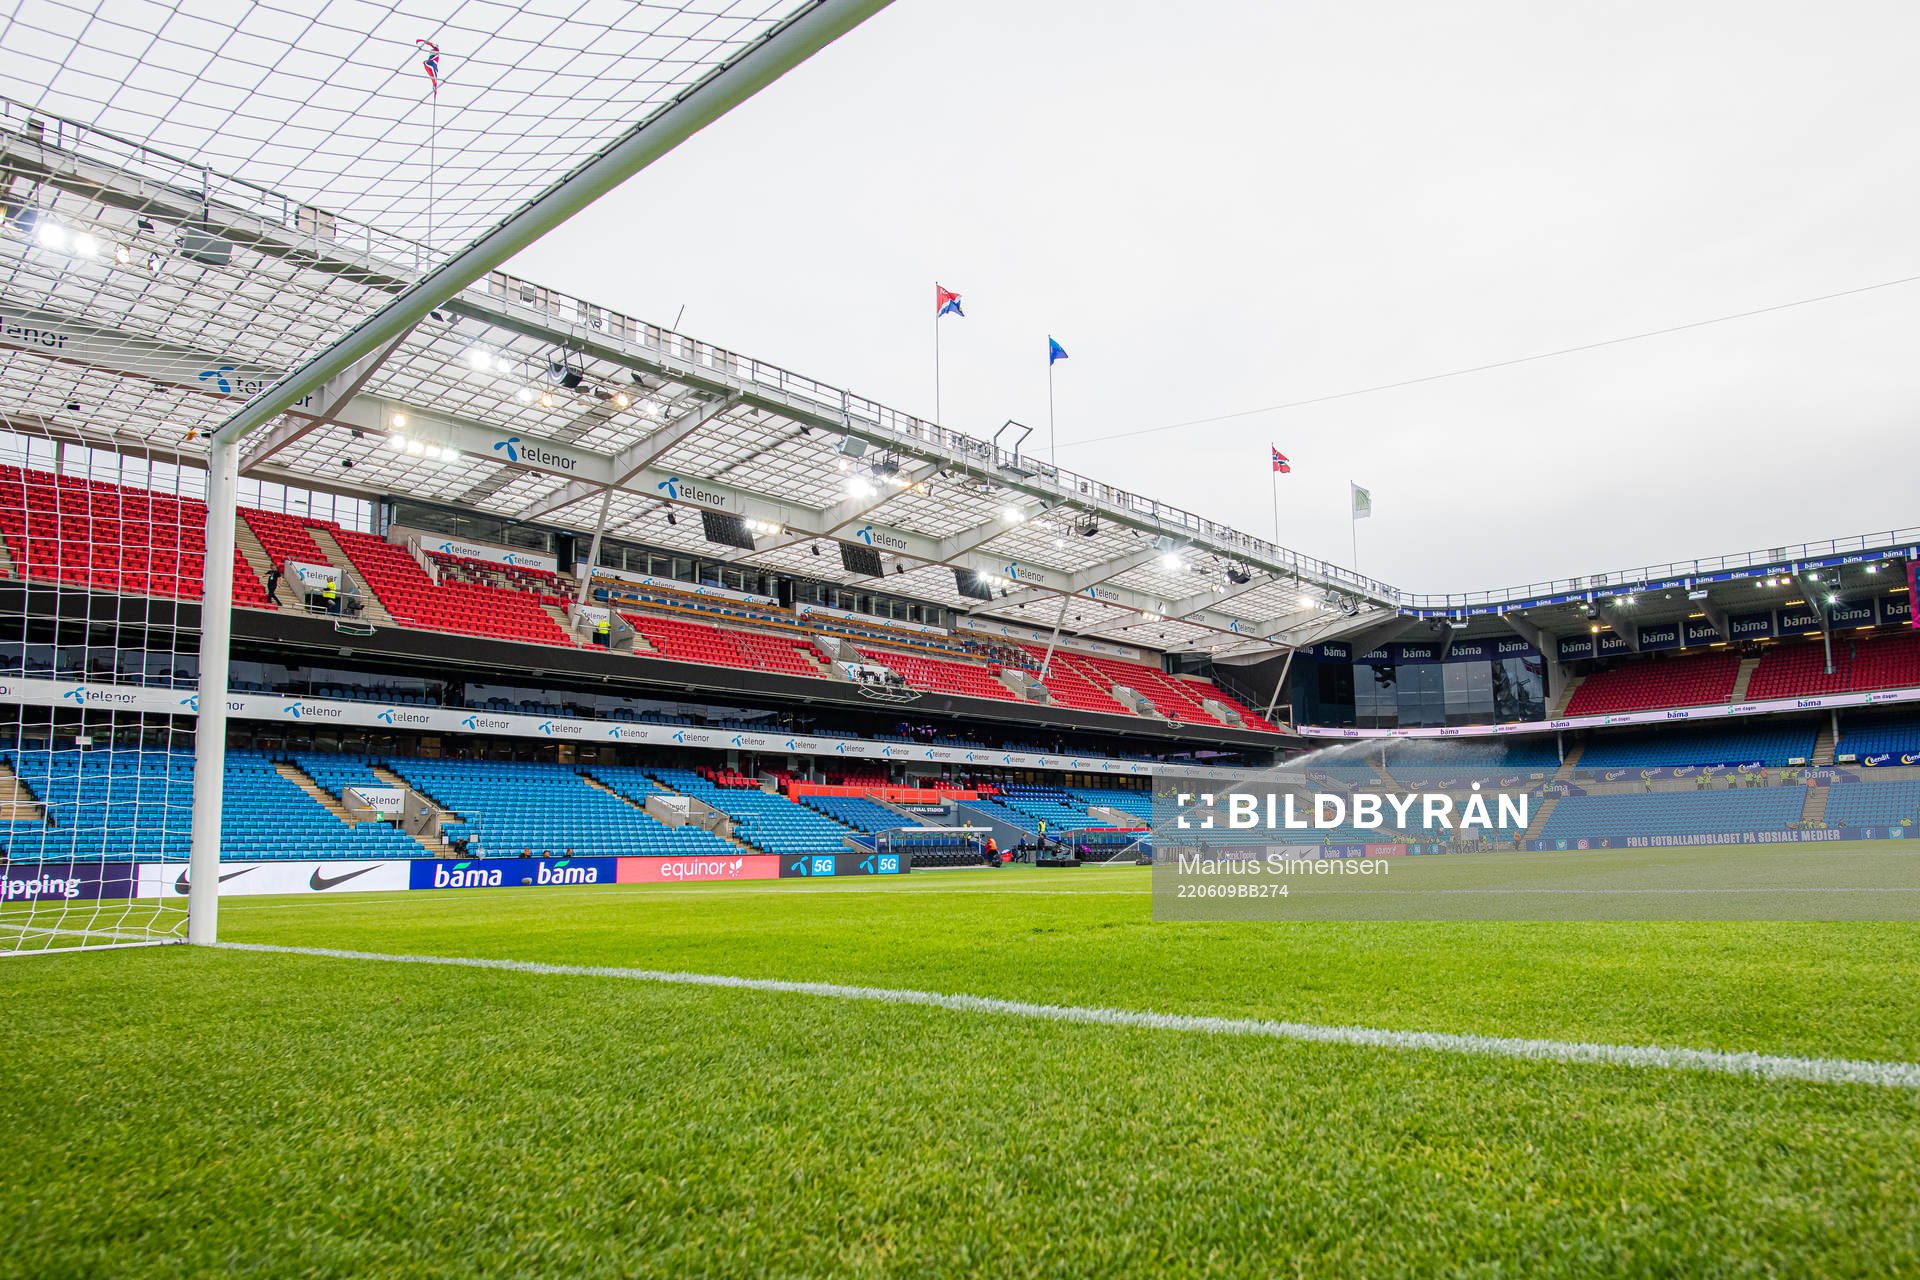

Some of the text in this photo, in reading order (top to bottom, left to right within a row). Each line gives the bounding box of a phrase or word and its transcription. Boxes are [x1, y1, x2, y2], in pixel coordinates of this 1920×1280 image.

[520, 444, 577, 471] telenor
[679, 484, 726, 507] telenor
[872, 532, 907, 550] telenor
[450, 544, 481, 557] telenor
[514, 553, 542, 568] telenor
[306, 570, 338, 582] telenr
[1017, 567, 1045, 583] telenor
[1096, 587, 1120, 601] telenor
[1833, 606, 1871, 621] bama
[1733, 619, 1768, 633] bama
[1783, 615, 1819, 627] bama
[1642, 631, 1675, 643] bama
[1324, 646, 1347, 658] bama
[1402, 648, 1431, 659] bama
[1452, 645, 1482, 656] bama
[1498, 642, 1529, 653] bama
[1562, 642, 1592, 653] bama
[86, 689, 137, 703] telenor
[1797, 700, 1822, 708] bama
[301, 705, 342, 718] telenor
[1667, 711, 1689, 719] bama
[393, 712, 430, 724] telenor
[476, 717, 510, 729] telenor
[551, 724, 583, 735] telenor
[1440, 727, 1459, 735] bama
[1550, 721, 1571, 729] bama
[620, 729, 649, 739] telenor
[683, 734, 710, 743] telenor
[741, 737, 766, 746] telenor
[795, 740, 817, 750] telenor
[843, 744, 865, 753] telenor
[889, 747, 910, 756] telenor
[1870, 753, 1890, 764] Bendit
[1708, 763, 1725, 773] Bendit
[1743, 761, 1761, 772] Bendit
[1805, 769, 1836, 778] bama
[367, 795, 400, 805] telenor
[1627, 836, 1649, 847] FØLG
[1758, 831, 1798, 843] SOSIALE
[1801, 829, 1840, 842] MEDIER
[661, 860, 727, 880] equinor
[814, 859, 833, 873] 5G
[880, 858, 897, 872] 5G
[434, 863, 503, 888] bama
[537, 861, 598, 885] bama
[0, 874, 80, 899] ipping
